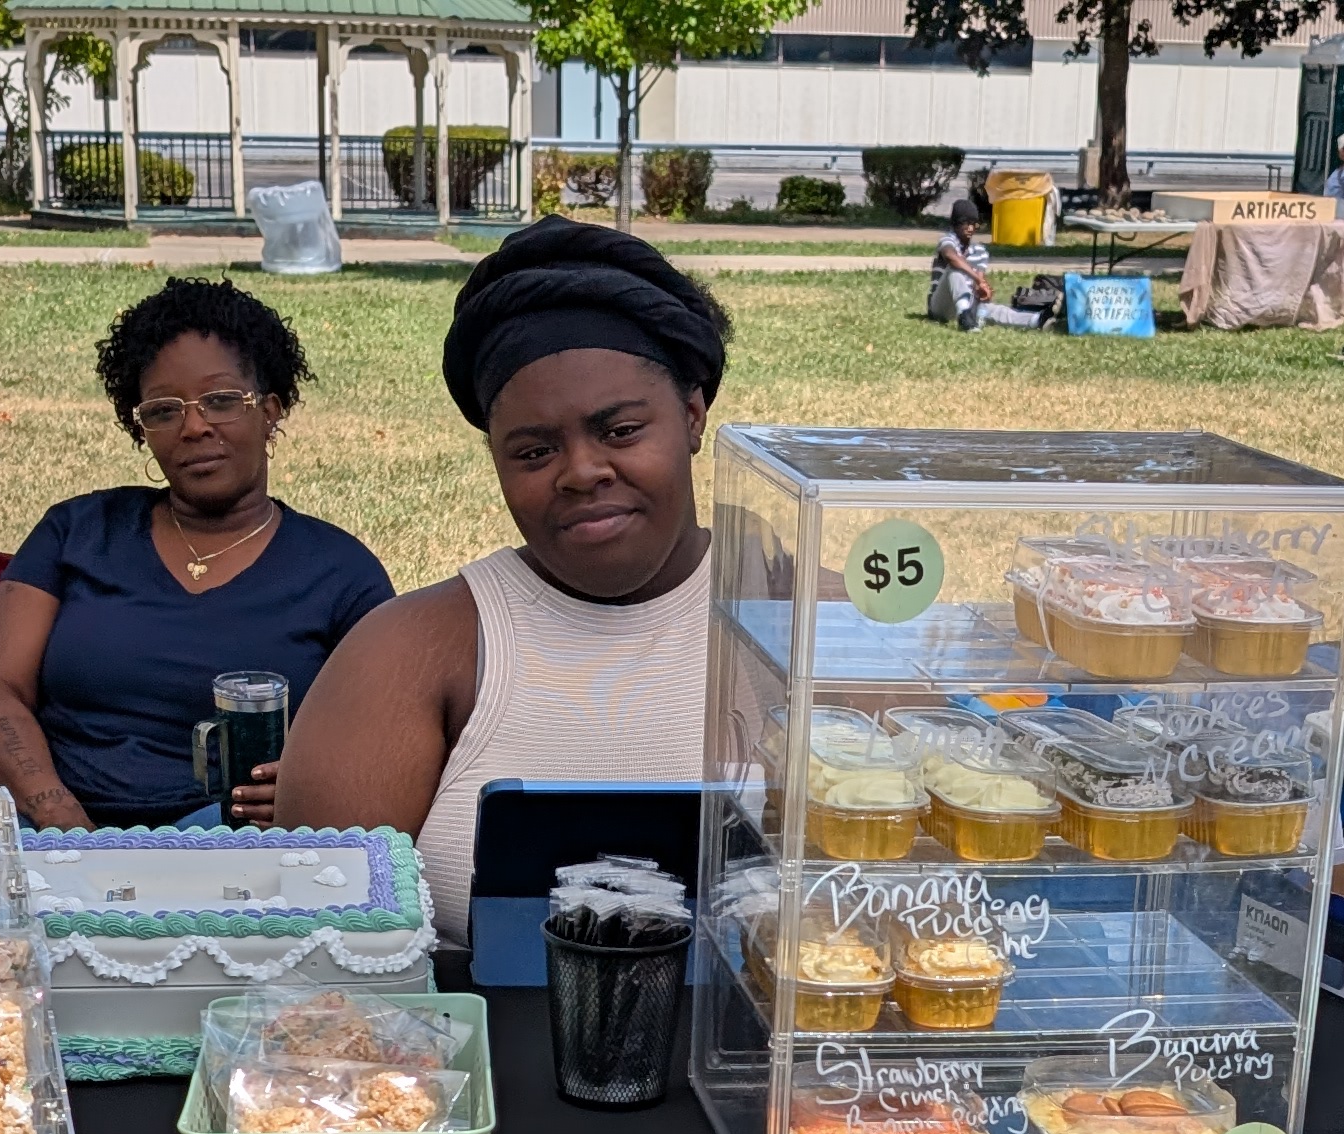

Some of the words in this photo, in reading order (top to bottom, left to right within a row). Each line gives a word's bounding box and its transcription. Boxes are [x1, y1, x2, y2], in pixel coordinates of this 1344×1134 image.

[1232, 201, 1317, 219] ARTIFACTS
[863, 546, 924, 594] $5
[1128, 690, 1290, 747] Cookies
[803, 862, 992, 945] Banana
[898, 894, 1050, 945] Pudding
[815, 1041, 984, 1106] Strawberry
[1098, 1008, 1260, 1105] Banana
[1166, 1051, 1274, 1091] Pudding
